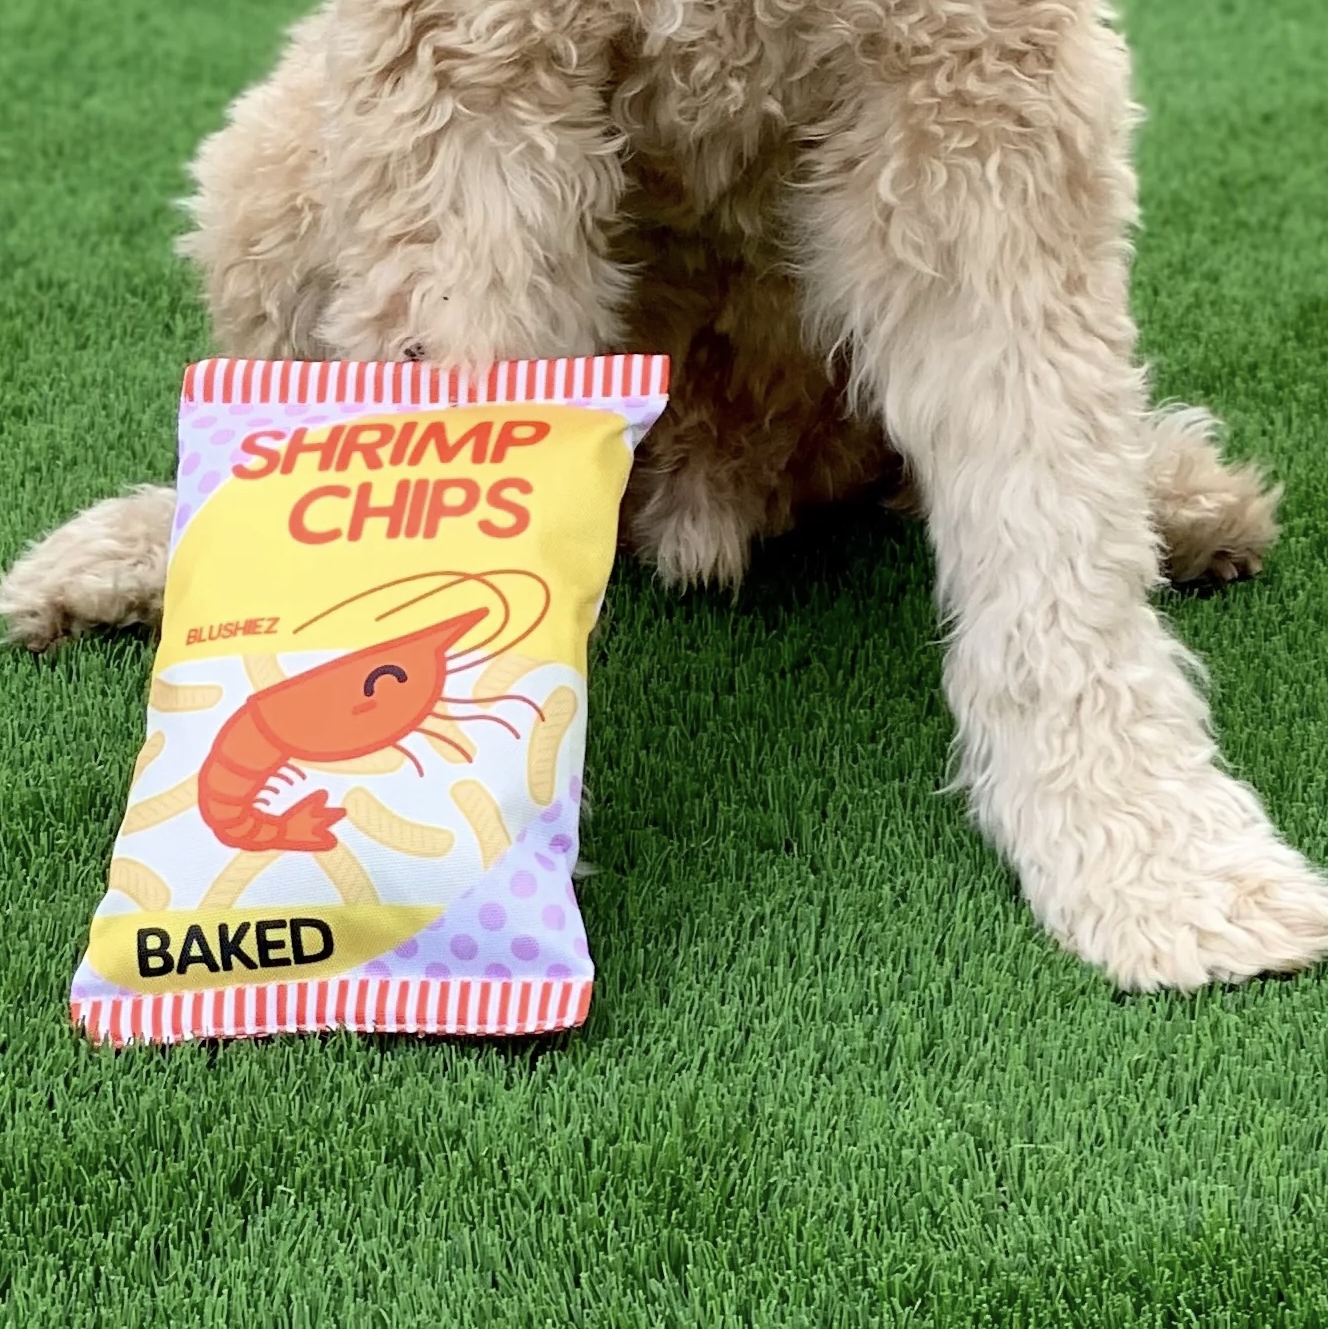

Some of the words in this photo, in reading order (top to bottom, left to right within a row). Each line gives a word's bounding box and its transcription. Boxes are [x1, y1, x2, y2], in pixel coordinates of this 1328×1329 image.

[232, 421, 551, 479] SHRIMP
[288, 478, 533, 544] CHIPS
[185, 616, 279, 646] BLUSHIEZ
[137, 917, 334, 977] BAKED
